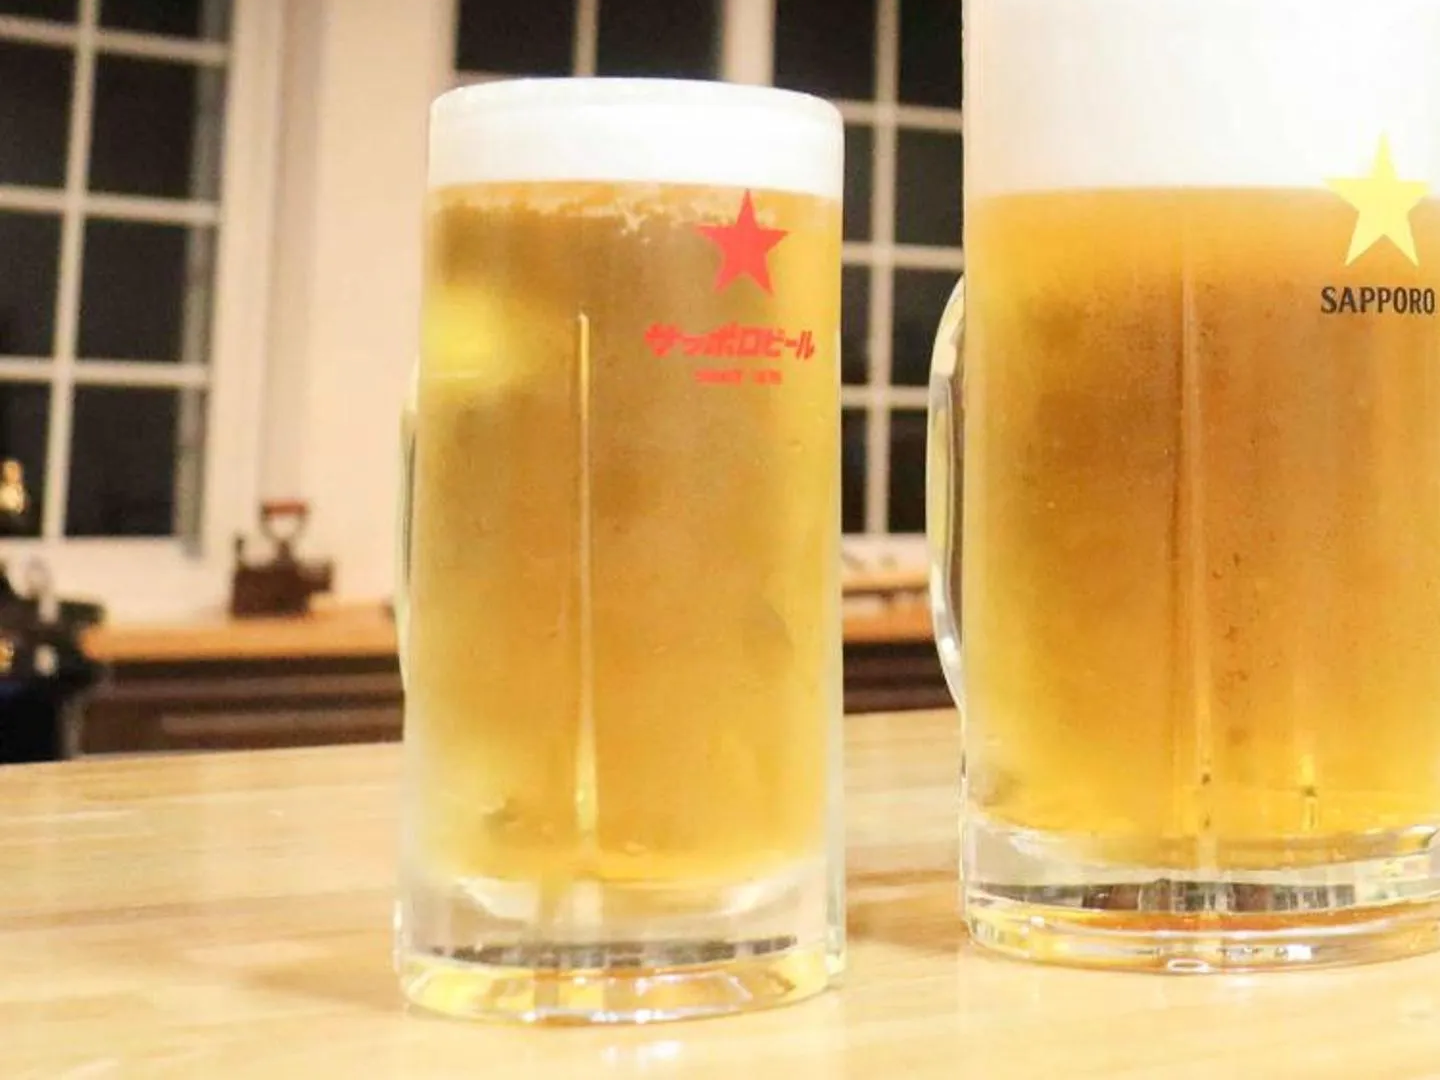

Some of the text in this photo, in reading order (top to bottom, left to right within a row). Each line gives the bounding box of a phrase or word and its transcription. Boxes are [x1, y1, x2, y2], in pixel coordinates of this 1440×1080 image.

[1320, 286, 1436, 314] SAPPORO
[645, 323, 815, 360] サッポロビール
